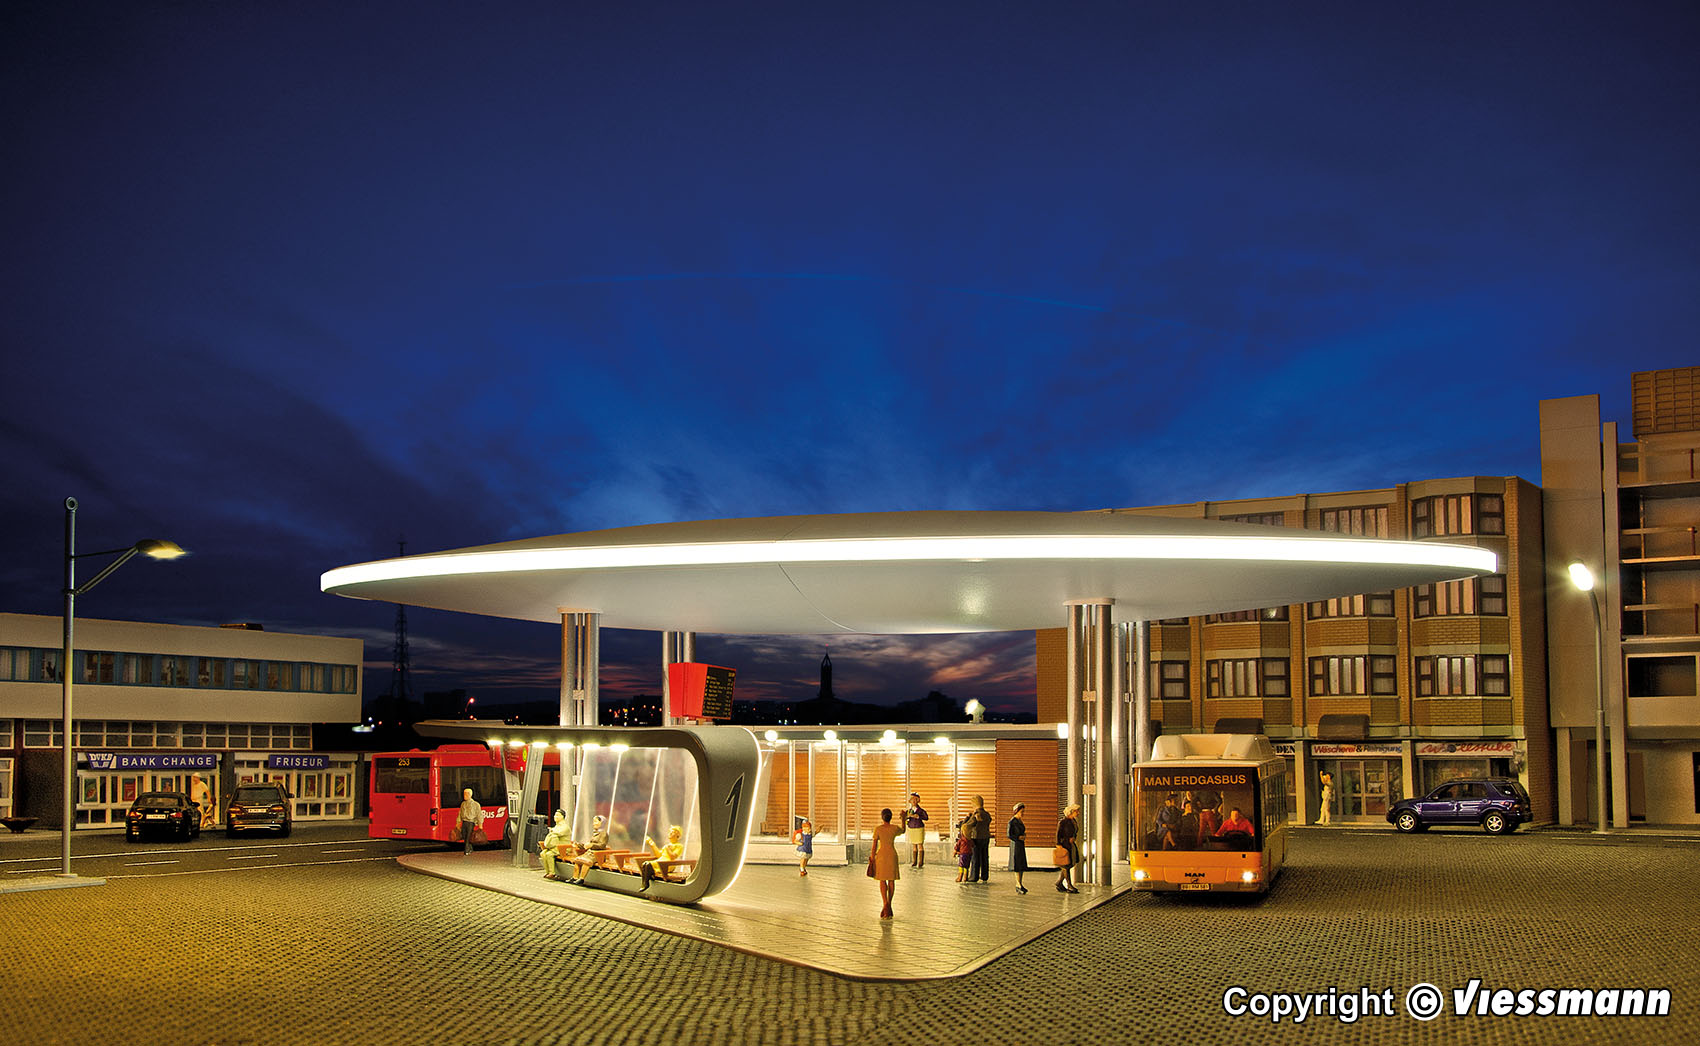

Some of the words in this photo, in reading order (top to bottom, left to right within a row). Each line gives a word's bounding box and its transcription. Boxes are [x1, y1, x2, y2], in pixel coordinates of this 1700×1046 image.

[121, 757, 156, 767] BANK
[162, 756, 212, 766] CHANGE
[275, 757, 323, 767] FRISEUR
[398, 758, 410, 766] 253
[1144, 775, 1171, 786] MAN
[1173, 774, 1247, 786] ERDGASBUS
[724, 772, 745, 842] 1
